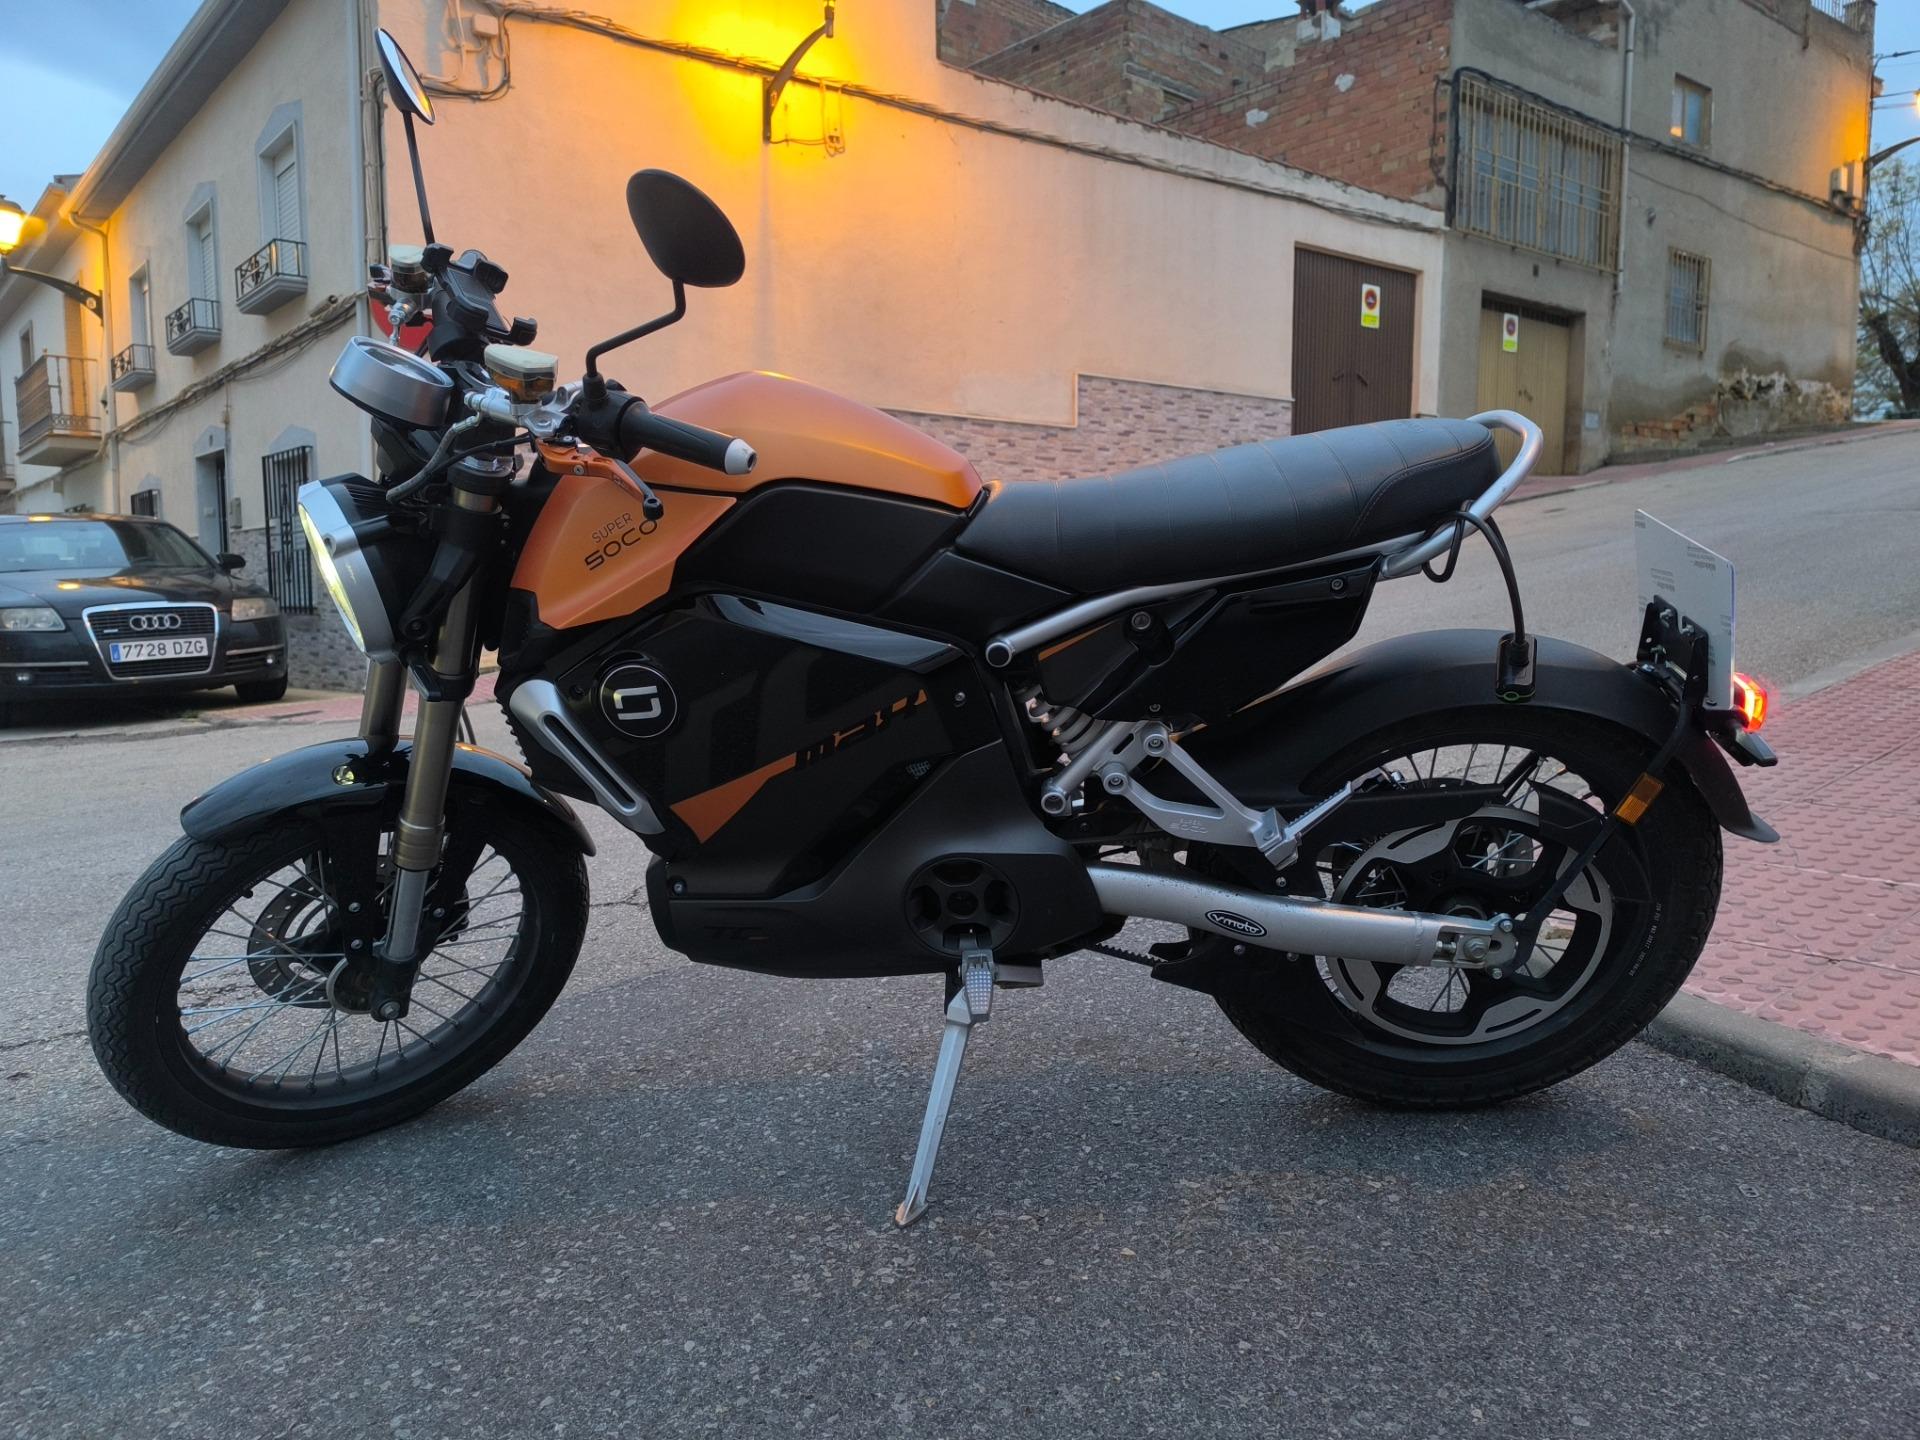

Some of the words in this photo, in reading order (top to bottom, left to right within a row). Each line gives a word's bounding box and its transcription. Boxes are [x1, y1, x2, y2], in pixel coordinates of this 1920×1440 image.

[592, 512, 633, 543] SUPER
[584, 519, 657, 571] SOCO
[123, 643, 167, 659] 7728
[173, 640, 204, 655] DZG
